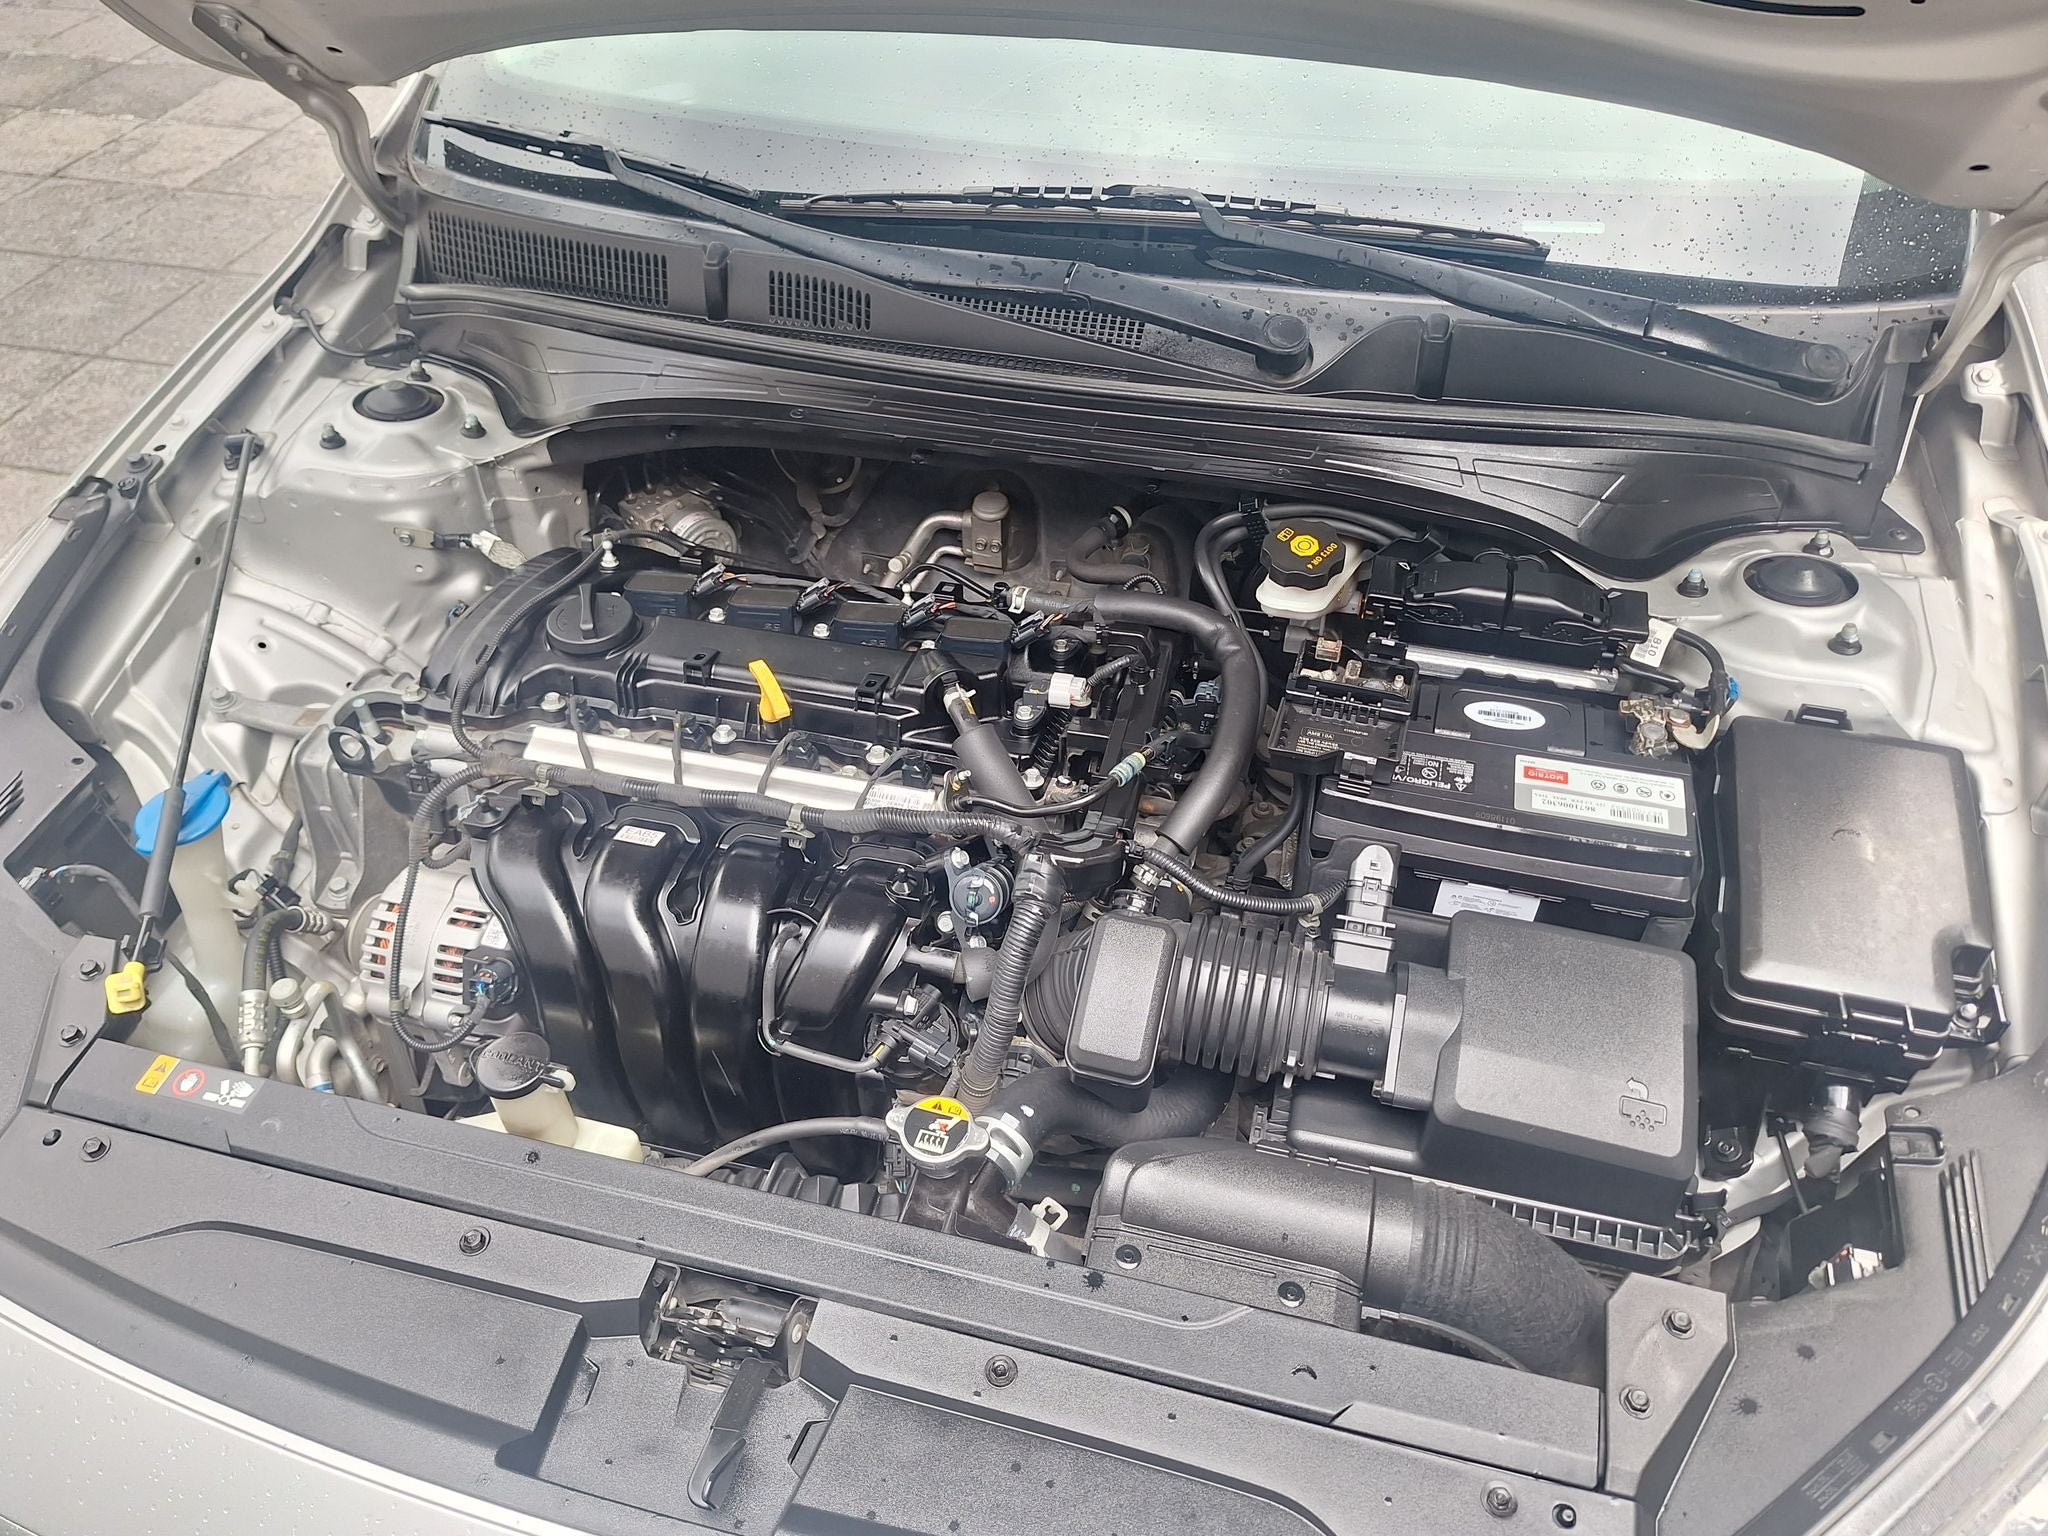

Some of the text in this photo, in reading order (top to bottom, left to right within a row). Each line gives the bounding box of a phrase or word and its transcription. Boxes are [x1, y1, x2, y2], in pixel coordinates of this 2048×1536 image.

[1320, 542, 1338, 558] DOT3
[1311, 555, 1323, 566] OR
[1647, 637, 1662, 657] B10
[1427, 760, 1440, 768] NO
[1528, 770, 1565, 781] MOTRIO
[481, 1048, 545, 1072] COOLANT
